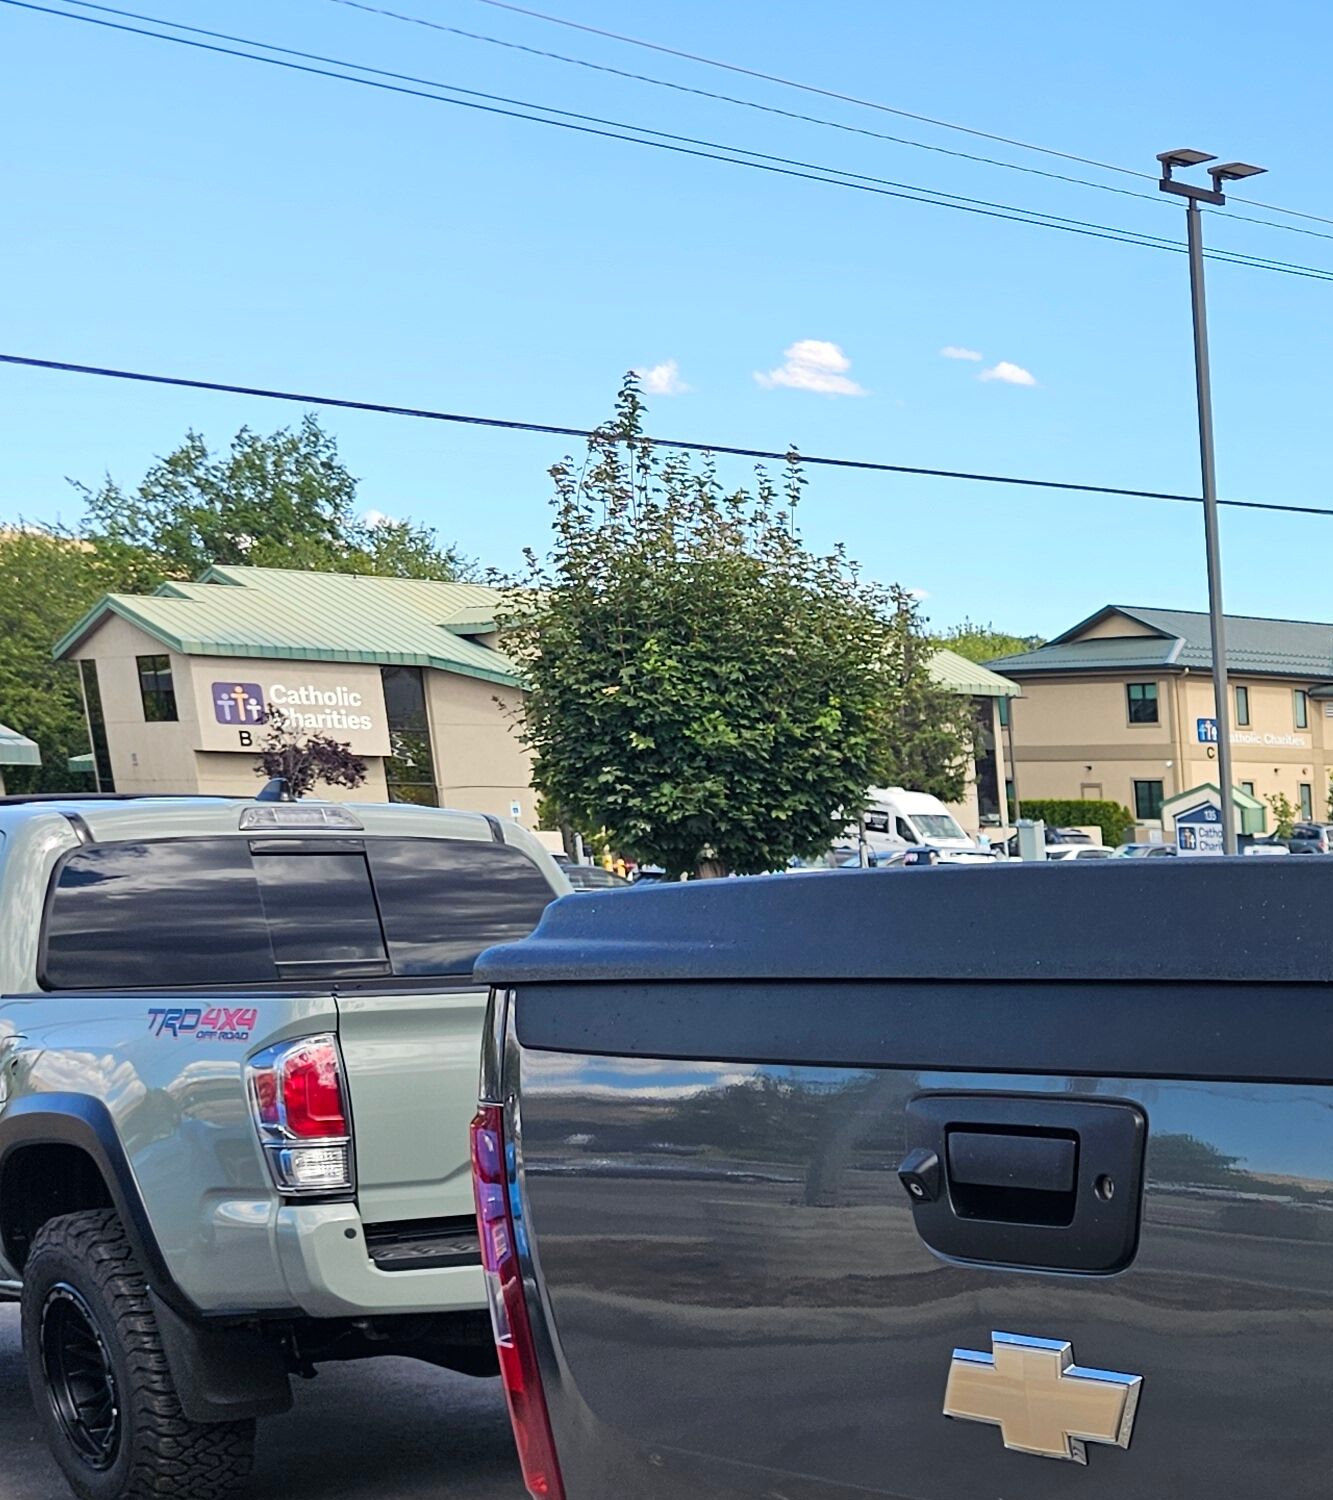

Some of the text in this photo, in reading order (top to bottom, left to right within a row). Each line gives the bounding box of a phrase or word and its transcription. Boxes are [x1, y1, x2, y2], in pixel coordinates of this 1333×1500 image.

[269, 684, 362, 707] Catholic
[238, 730, 253, 747] B
[1229, 733, 1260, 744] atholic
[1206, 746, 1215, 759] C
[1199, 827, 1222, 838] Catho
[148, 1008, 201, 1037] TRD
[196, 1031, 249, 1040] OFF ROAD
